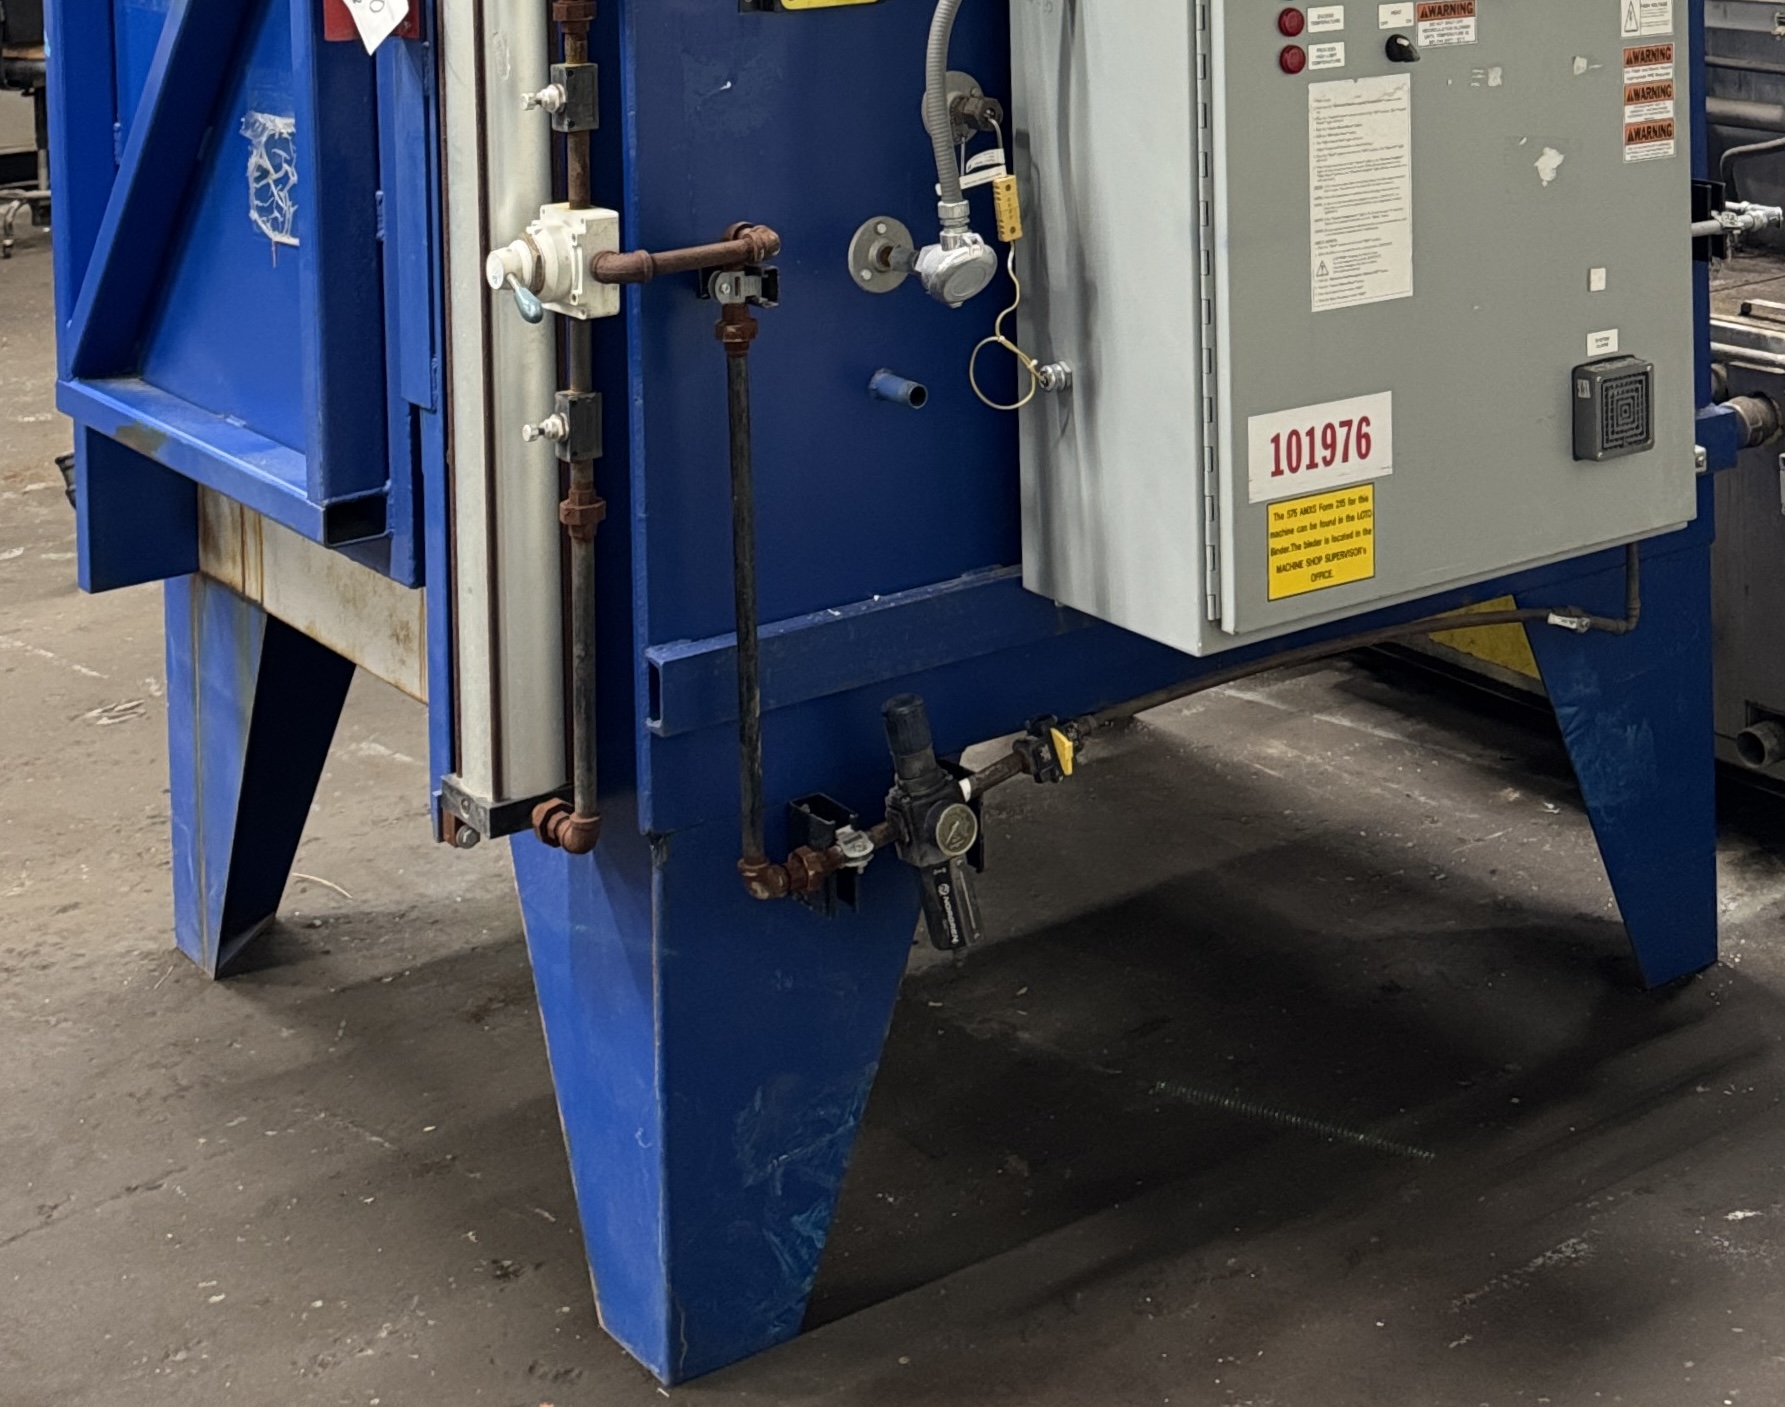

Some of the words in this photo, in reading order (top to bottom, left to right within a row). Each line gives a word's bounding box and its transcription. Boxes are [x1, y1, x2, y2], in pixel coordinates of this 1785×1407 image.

[1428, 1, 1473, 18] WARNING
[1632, 46, 1671, 64] WARNING
[1633, 84, 1671, 101] WARNING
[1634, 123, 1672, 141] WARNING
[1270, 416, 1371, 477] 101976
[1273, 511, 1284, 522] The
[1348, 496, 1356, 506] for
[1358, 494, 1369, 504] this
[1296, 524, 1307, 533] can
[1309, 521, 1317, 530] be
[1346, 513, 1355, 523] the
[1331, 530, 1354, 543] located
[1362, 527, 1372, 537] the
[1276, 559, 1304, 574] MACHINE
[1305, 555, 1323, 567] SHOP
